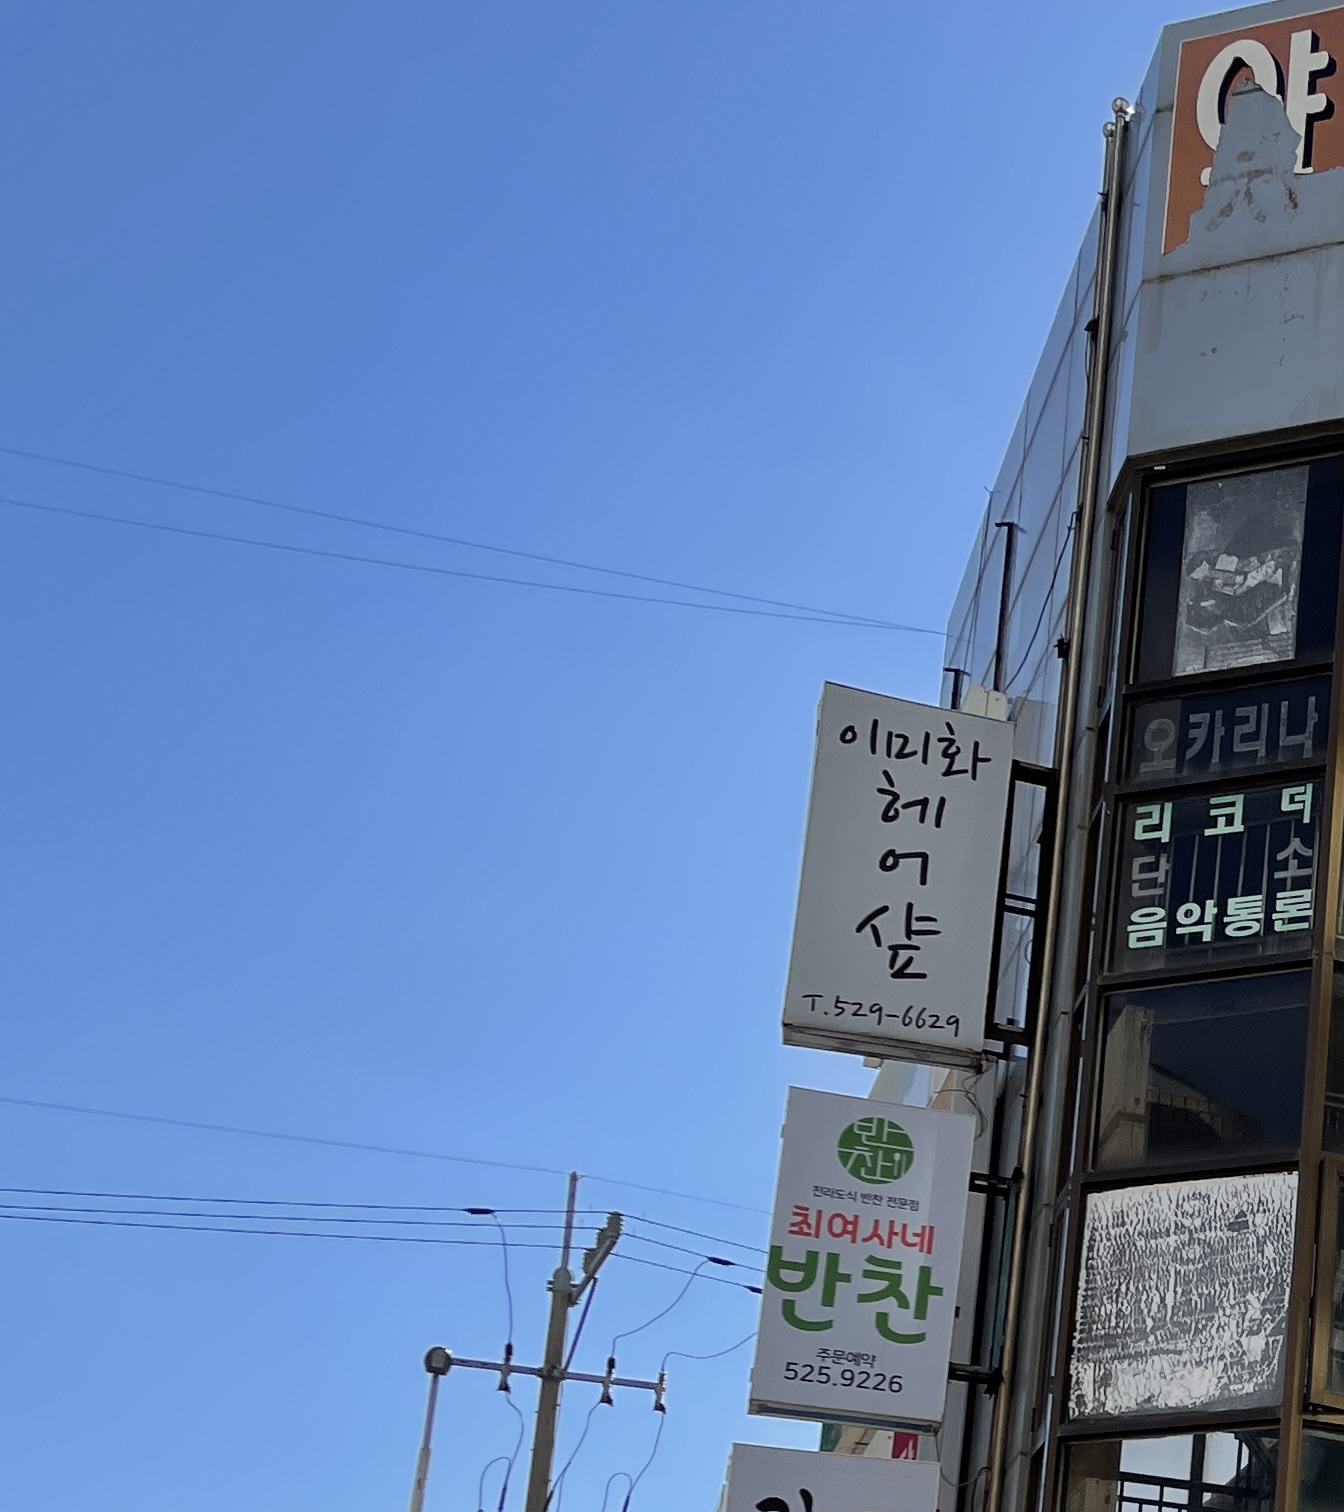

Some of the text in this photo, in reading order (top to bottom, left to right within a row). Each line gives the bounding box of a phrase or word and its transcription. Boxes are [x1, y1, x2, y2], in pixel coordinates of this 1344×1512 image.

[839, 718, 992, 781] 이미화
[1138, 696, 1319, 775] 오카리나
[1133, 783, 1314, 844] 리코더
[1126, 889, 1314, 950] 음악통론
[801, 993, 960, 1038] T.529-6629
[787, 1204, 935, 1255] 최여사네
[766, 1244, 944, 1345] 반찬
[783, 1362, 904, 1394] 525.9226
